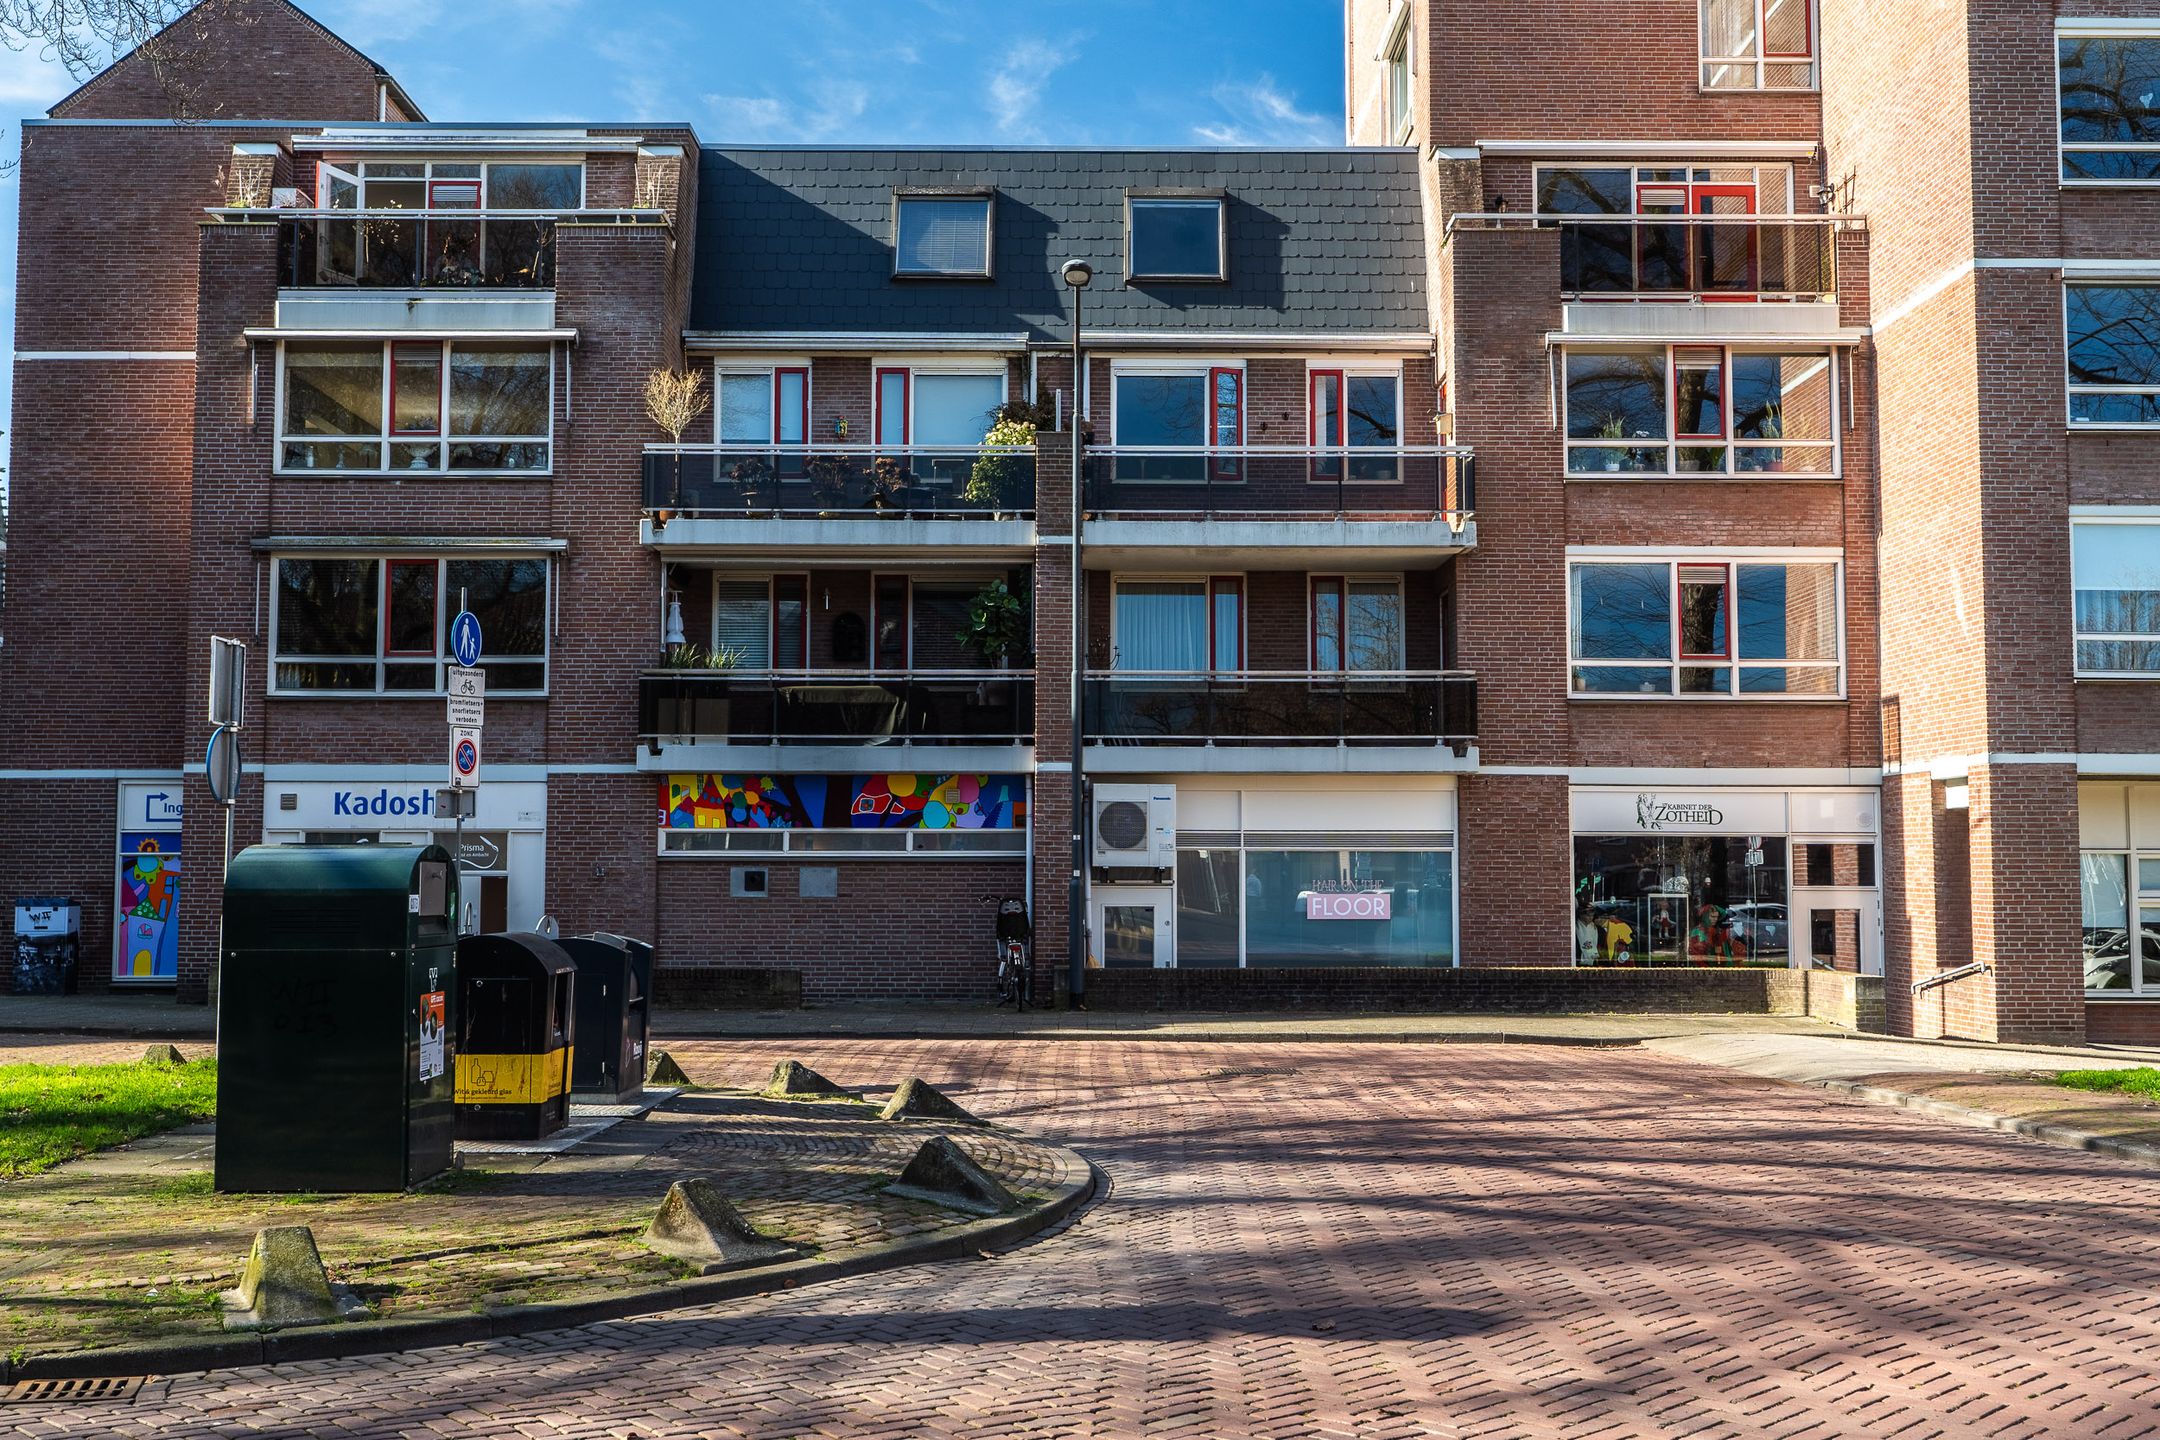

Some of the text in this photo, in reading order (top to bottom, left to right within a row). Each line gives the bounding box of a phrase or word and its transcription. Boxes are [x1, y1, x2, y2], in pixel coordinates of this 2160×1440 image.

[452, 669, 484, 677] uitgezonderd
[1655, 806, 1723, 826] ZOTHEID
[1312, 879, 1384, 892] HAIR ON THE
[1312, 897, 1385, 916] FLOOR
[499, 1088, 513, 1096] glas
